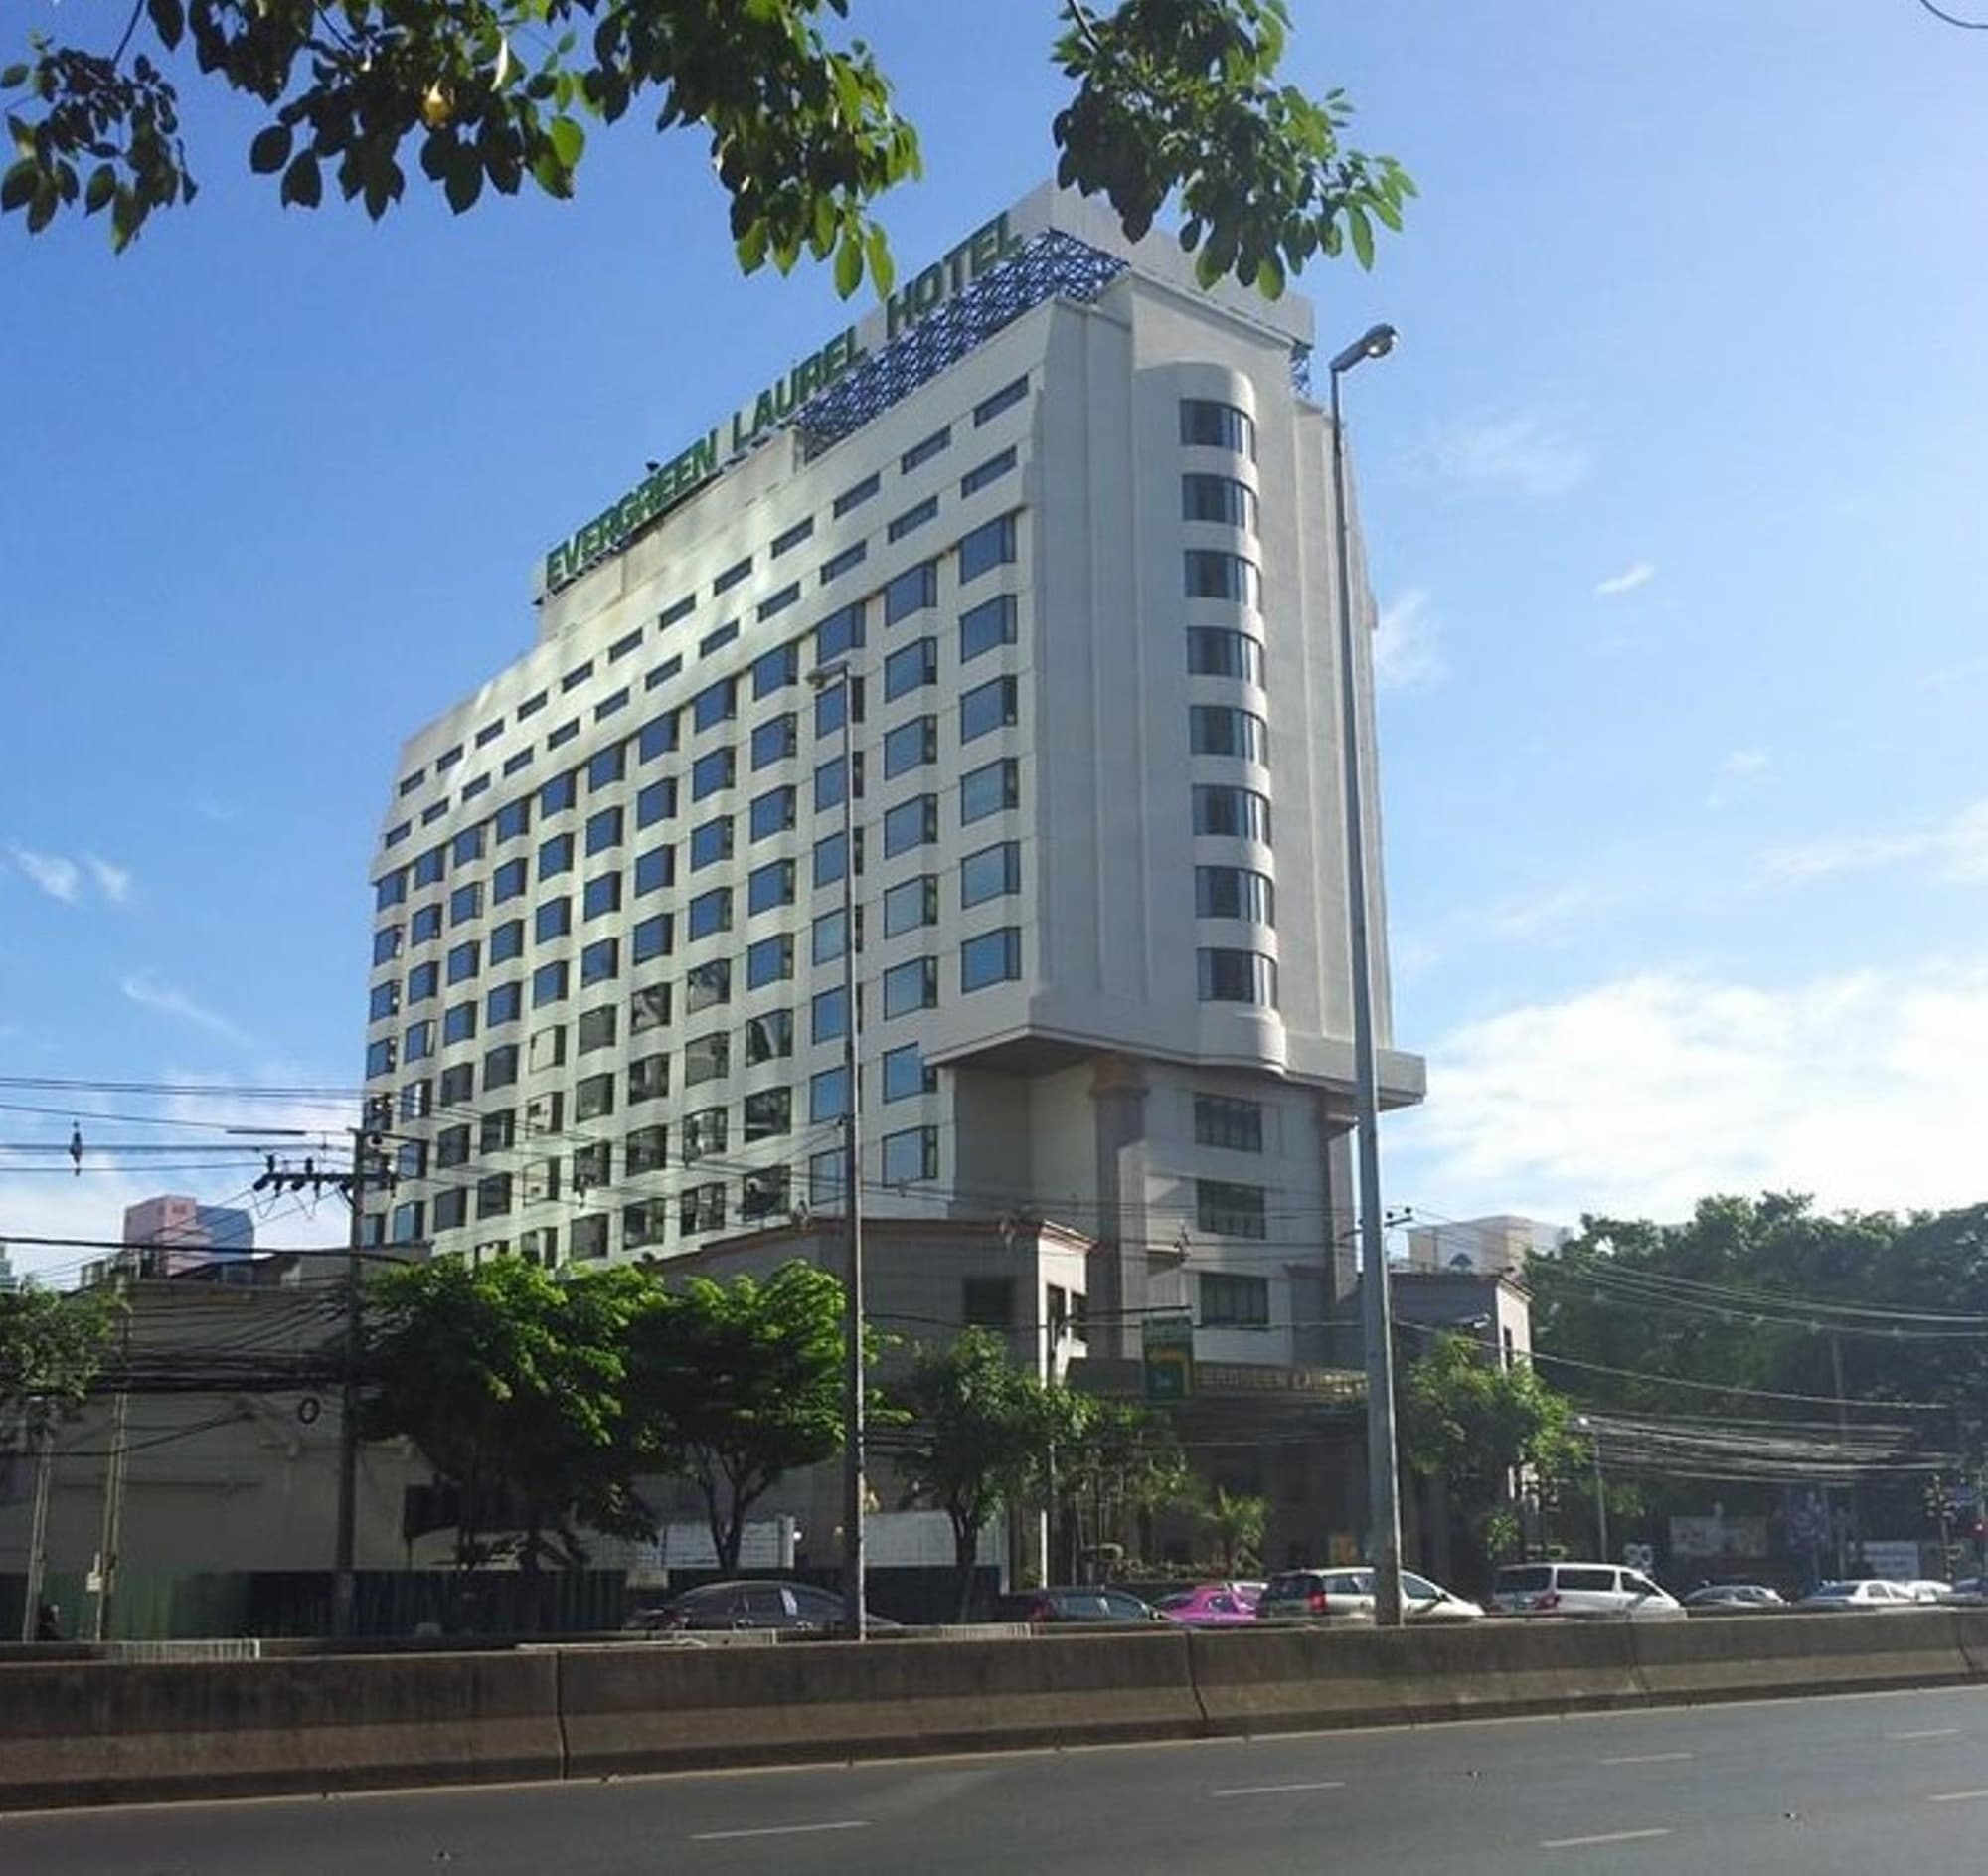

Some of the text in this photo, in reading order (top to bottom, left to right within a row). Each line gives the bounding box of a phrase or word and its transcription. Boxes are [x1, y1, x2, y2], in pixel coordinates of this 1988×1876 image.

[546, 210, 1024, 590] EVERGREEN LAUREL HOTEL
